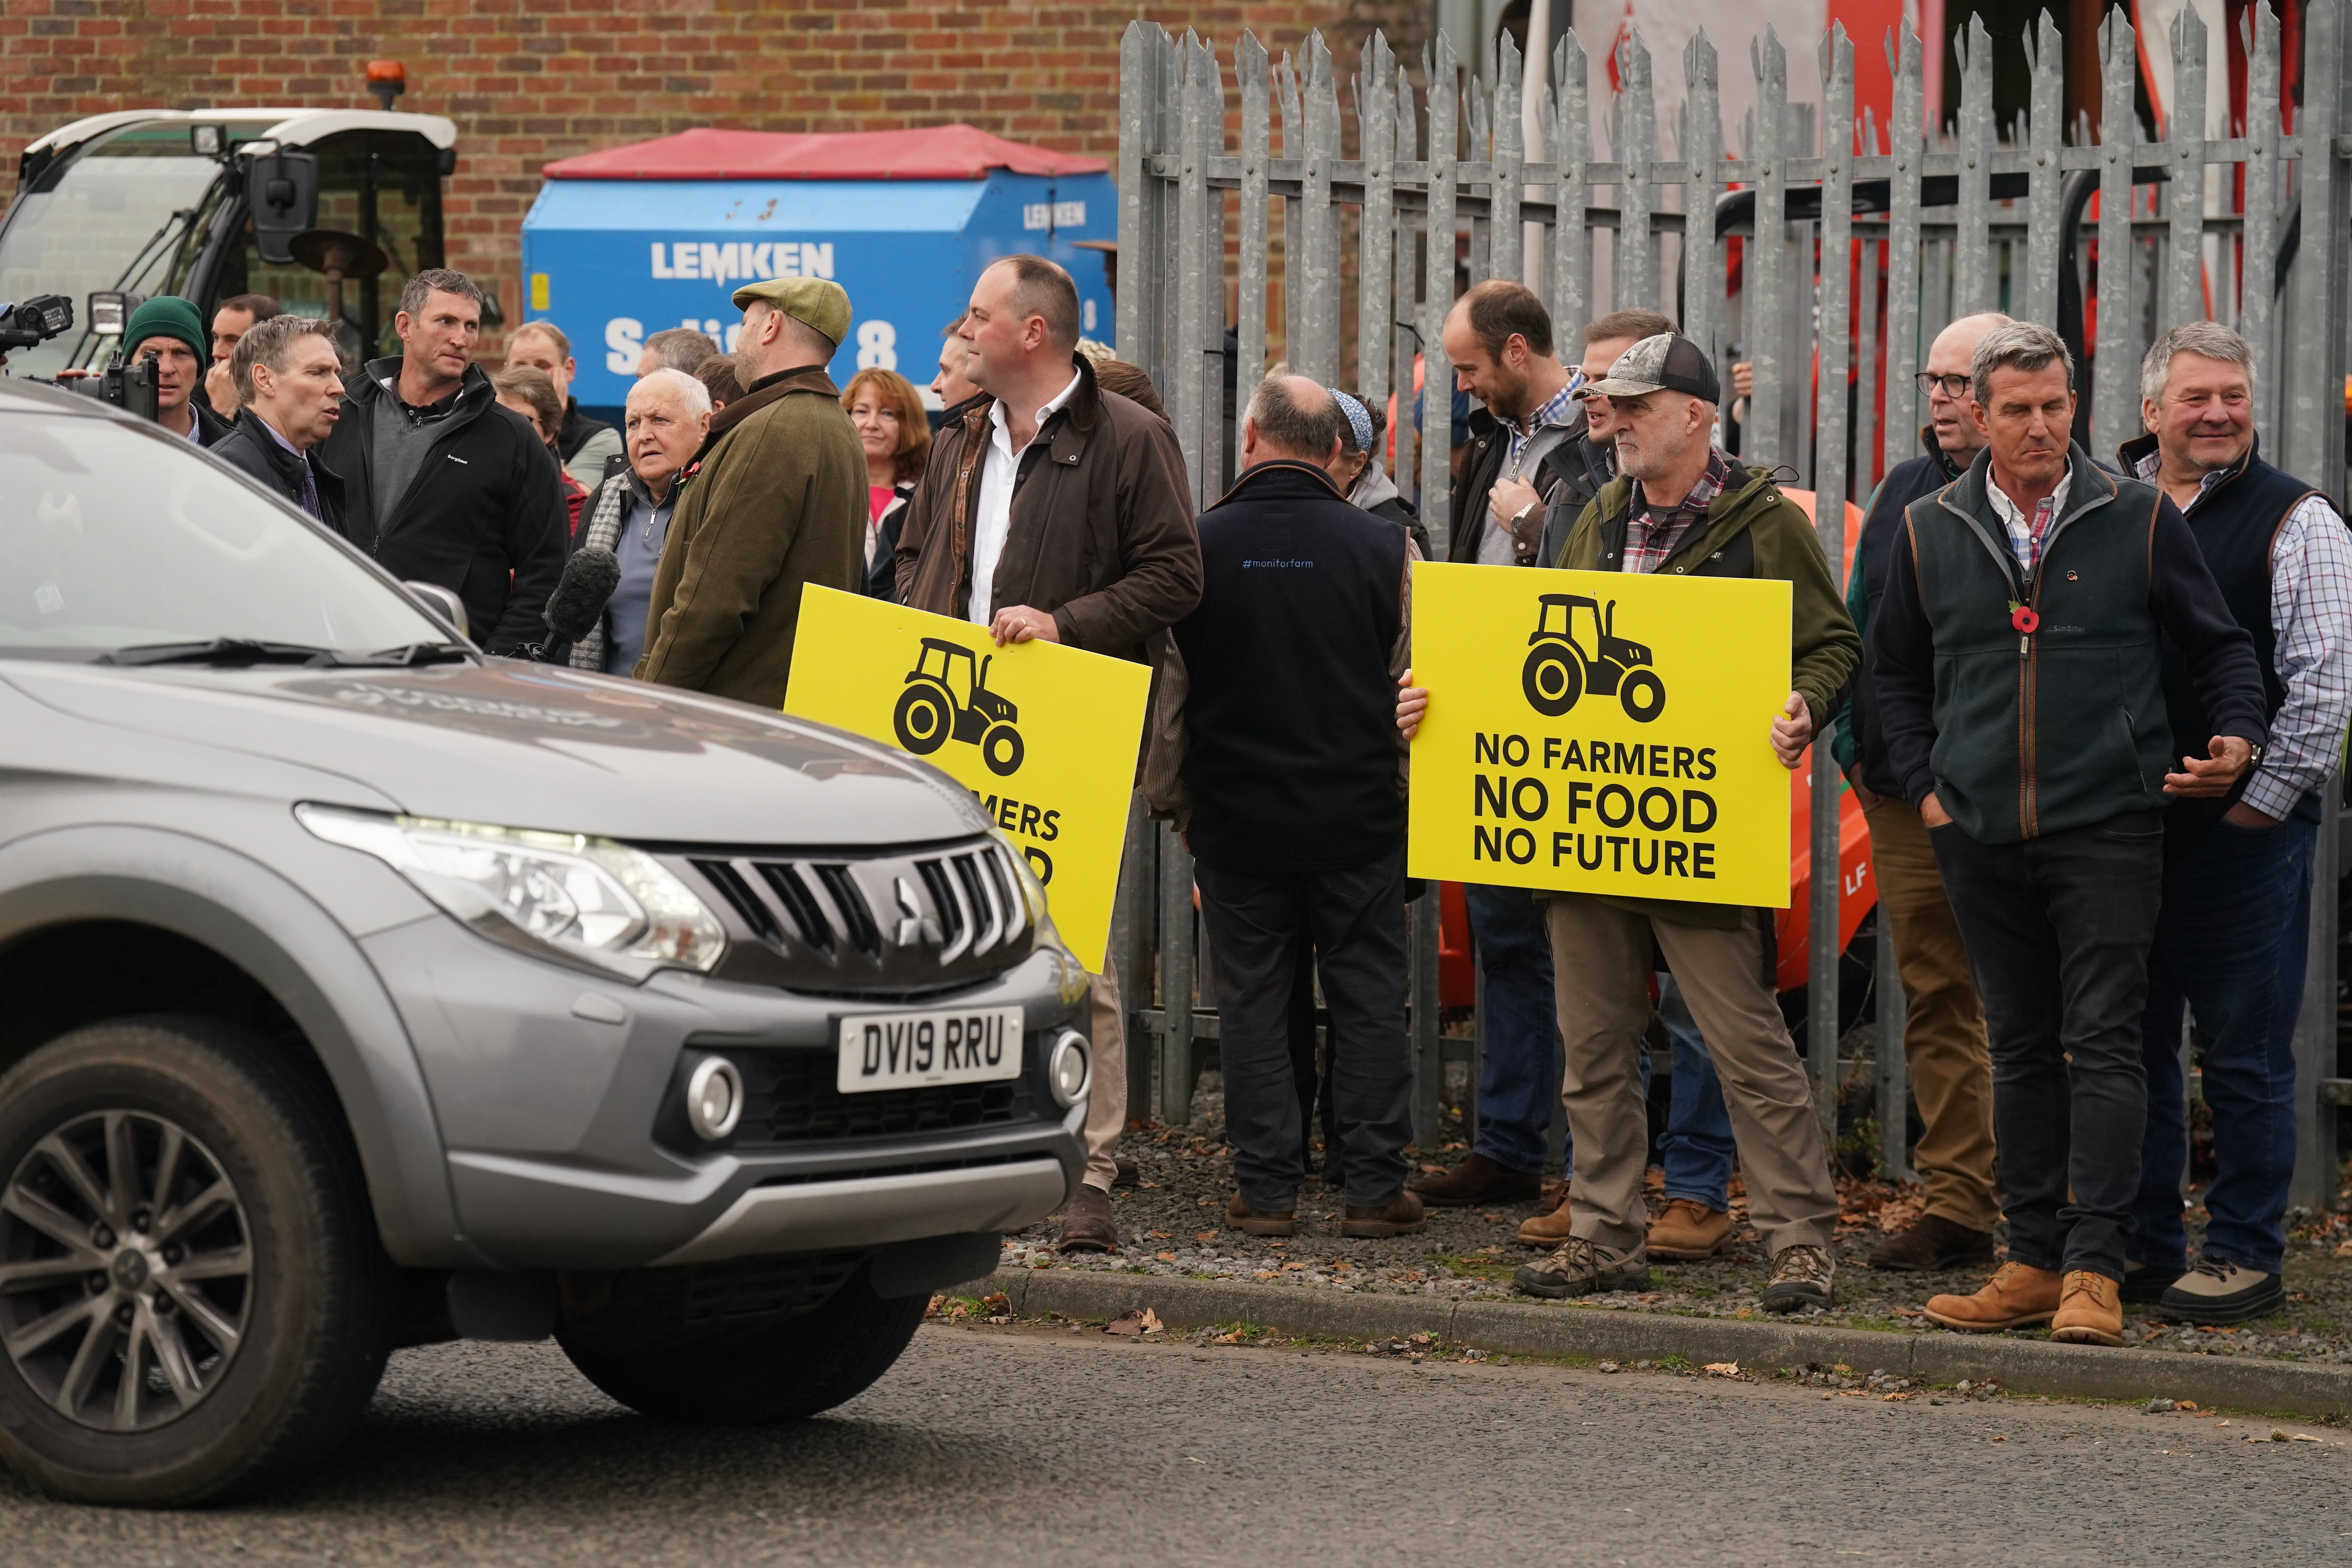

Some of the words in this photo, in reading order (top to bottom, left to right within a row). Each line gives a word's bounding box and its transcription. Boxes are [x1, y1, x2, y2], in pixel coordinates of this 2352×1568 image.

[651, 242, 834, 289] LEMKEN
[857, 319, 898, 372] 8
[448, 454, 468, 464] berghaus
[1242, 559, 1313, 568] #monitorfarm
[1475, 732, 1530, 767] NO
[1544, 737, 1717, 780] FARMERS
[1474, 774, 1548, 822] NO
[1568, 781, 1717, 833] FOOD
[1474, 825, 1536, 865] NO
[1553, 831, 1715, 879] FUTURE
[862, 1021, 935, 1077] DV19
[944, 1015, 1003, 1070] RRU
